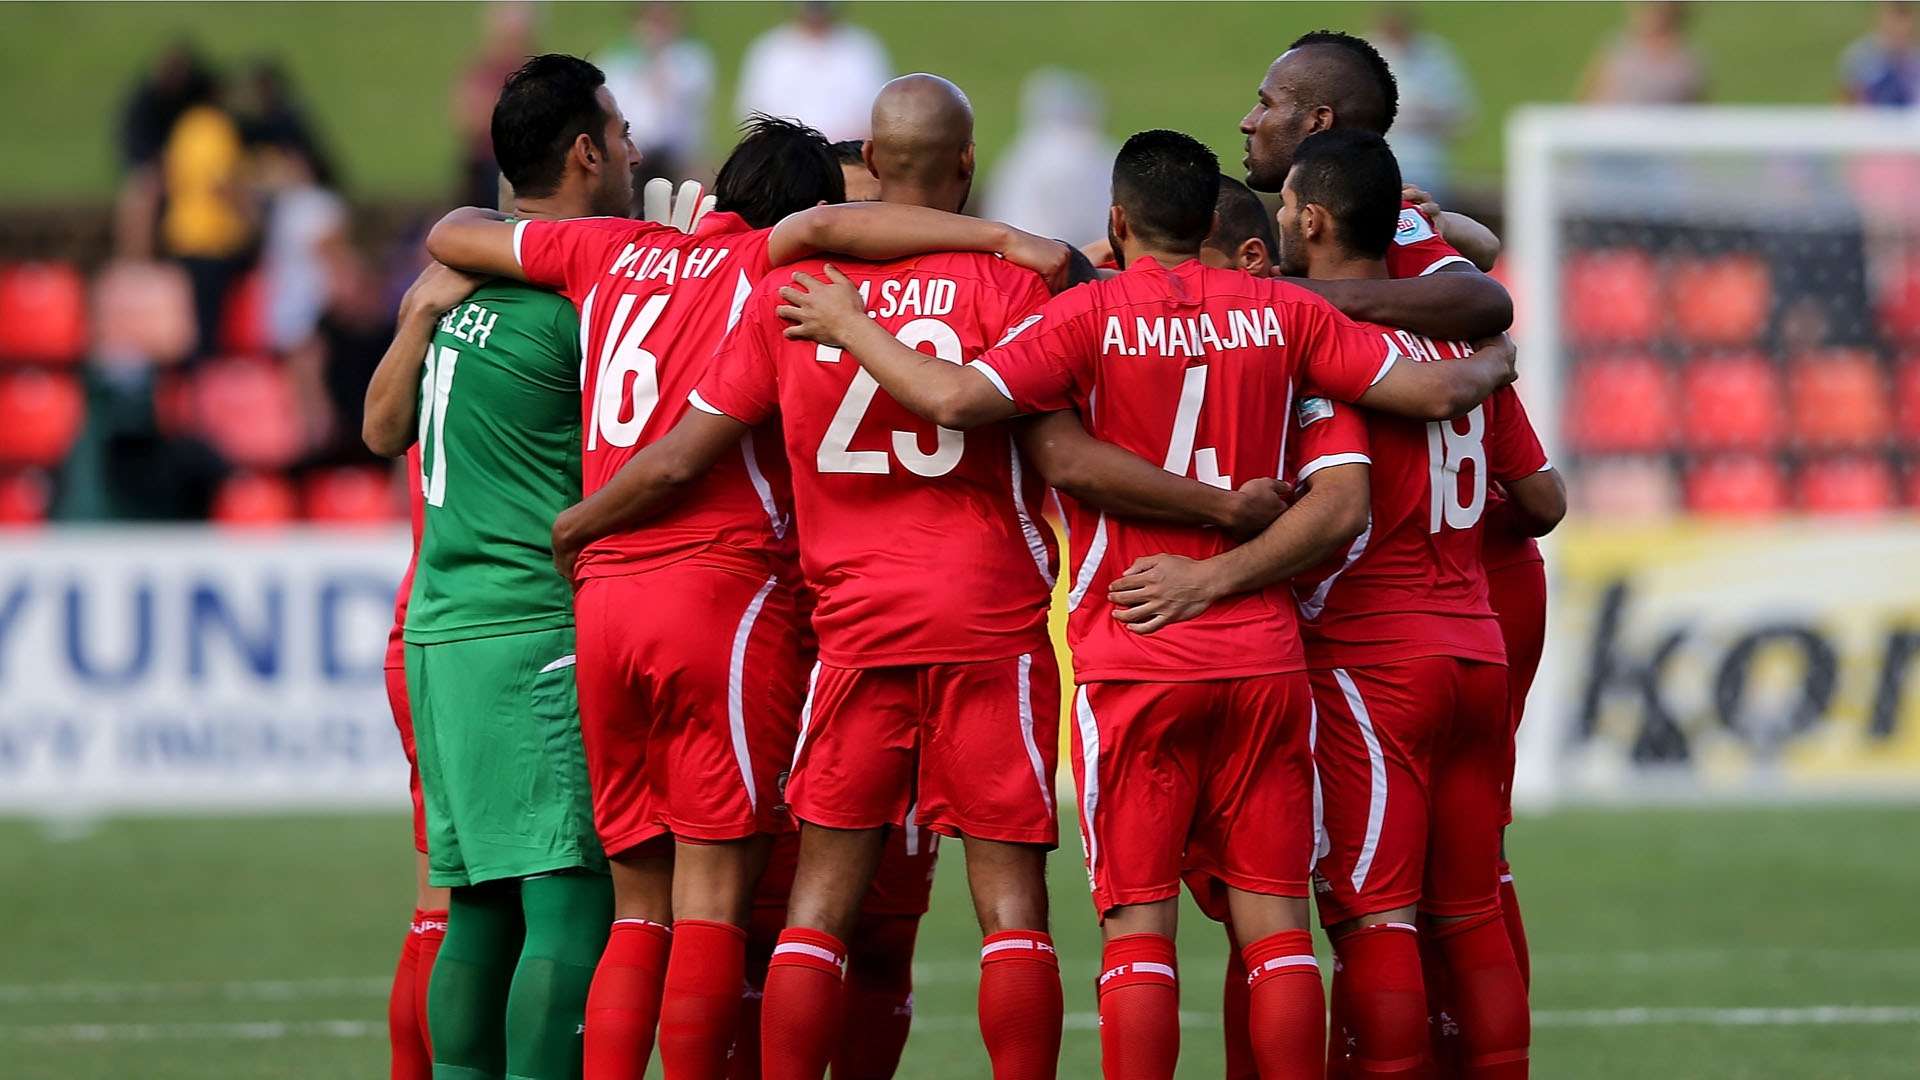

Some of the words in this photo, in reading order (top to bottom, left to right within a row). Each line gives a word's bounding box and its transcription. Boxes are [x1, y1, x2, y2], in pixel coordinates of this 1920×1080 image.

[587, 293, 660, 451] 16
[815, 318, 965, 477] 23
[1163, 364, 1232, 491] 4
[1426, 404, 1487, 535] 18
